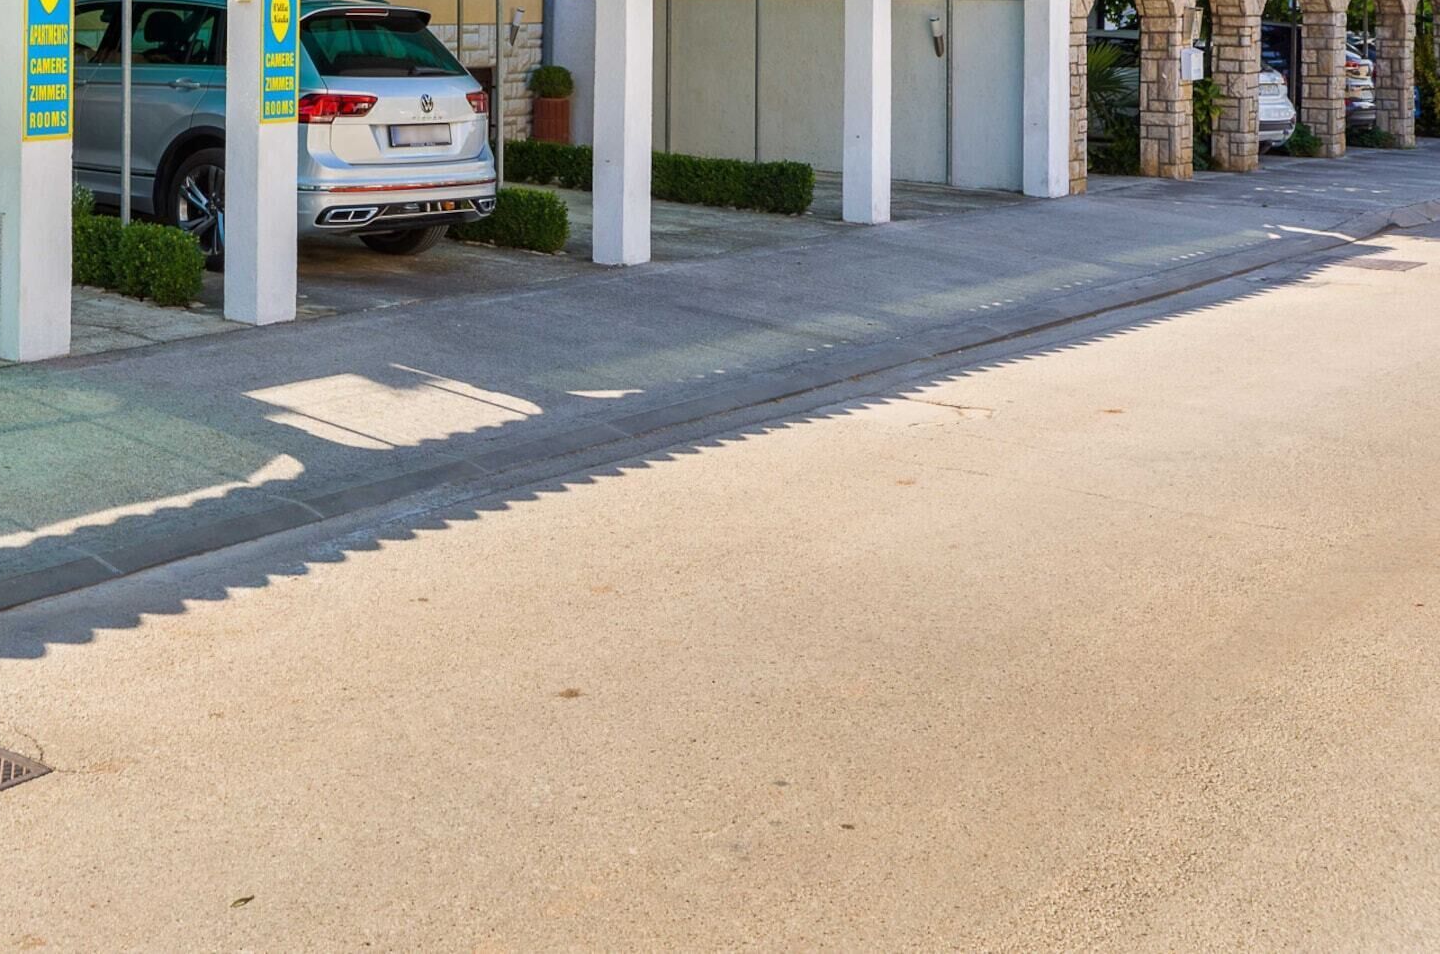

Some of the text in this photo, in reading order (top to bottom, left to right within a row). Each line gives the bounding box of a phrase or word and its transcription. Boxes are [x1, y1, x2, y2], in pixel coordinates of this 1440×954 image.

[29, 23, 68, 46] APARTMENTS
[30, 57, 67, 75] CAMERE
[265, 52, 294, 67] CAMERE
[29, 84, 67, 102] ZIMMER
[265, 77, 294, 92] ZIMMER
[265, 100, 294, 115] ROOMS
[29, 111, 67, 128] ROOMS
